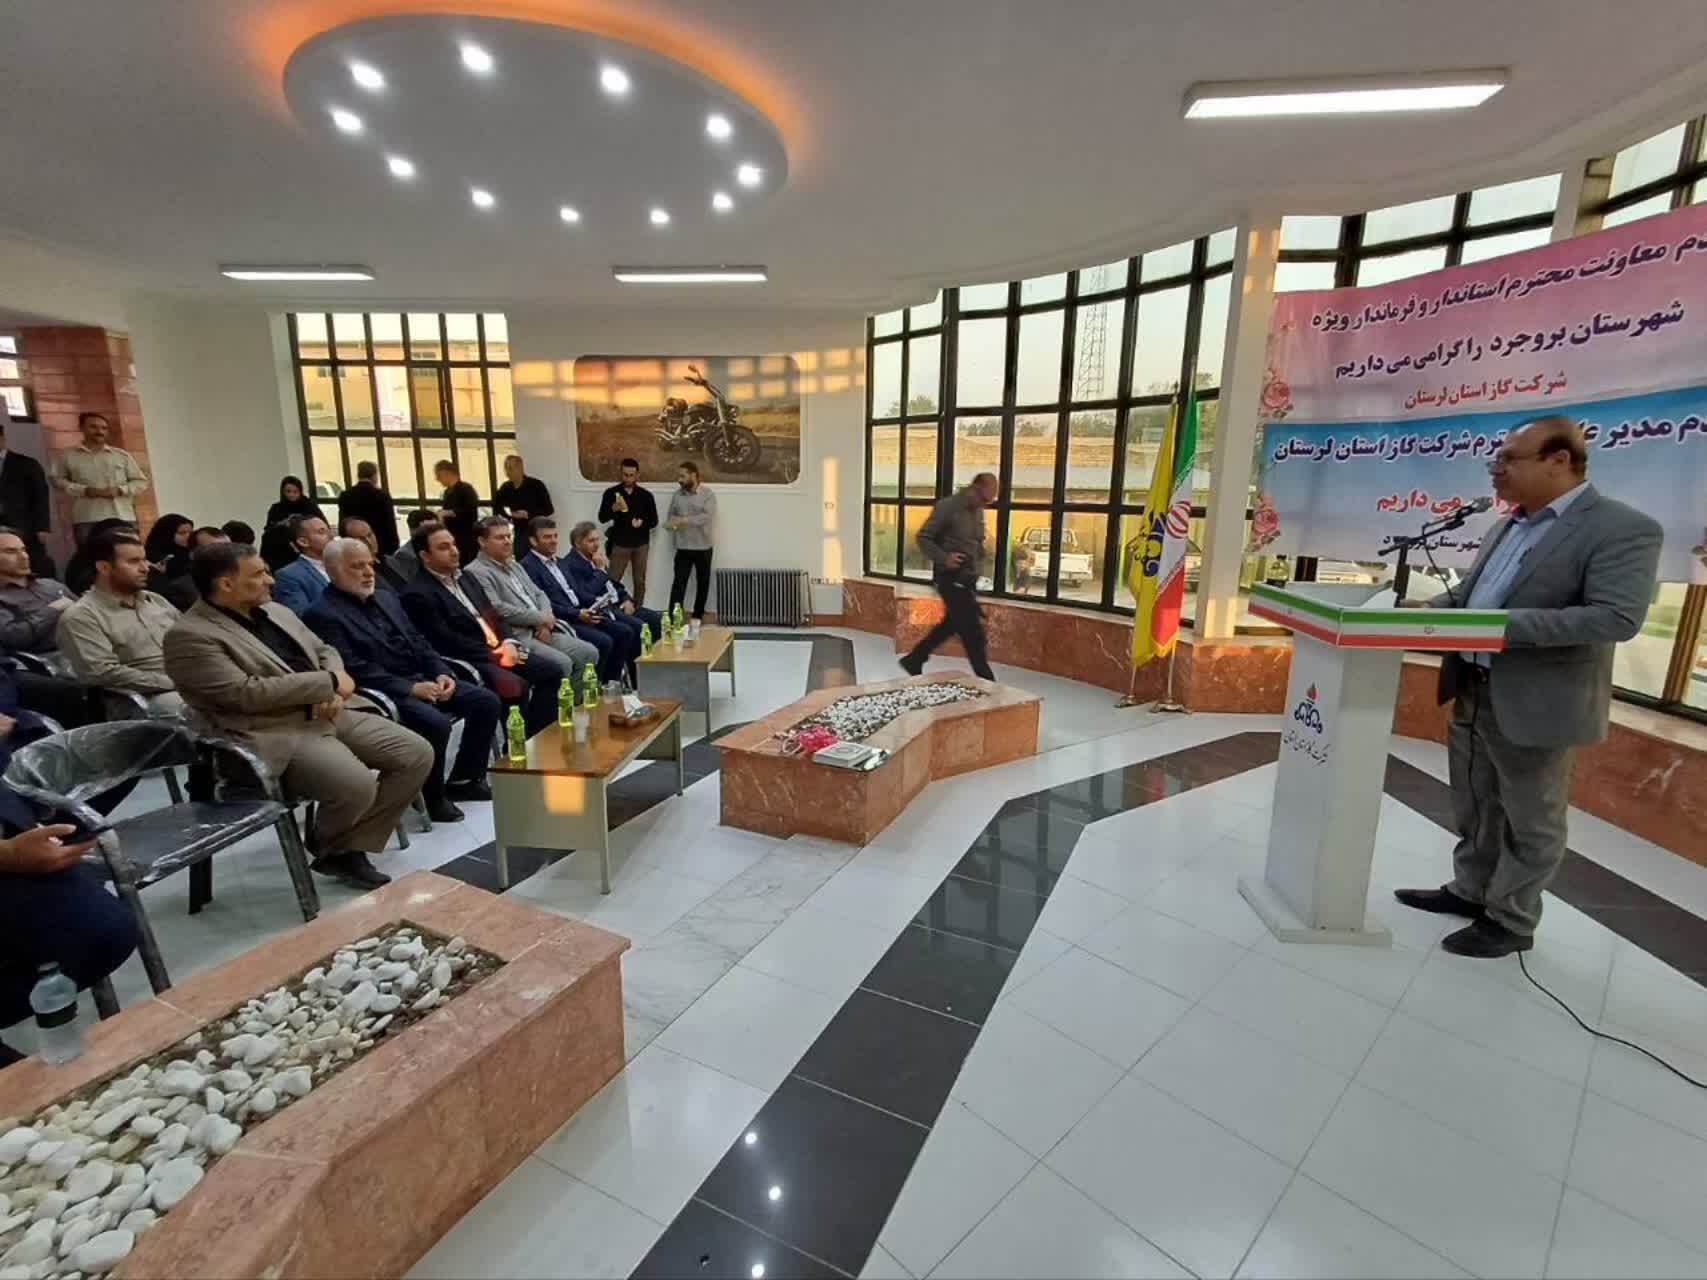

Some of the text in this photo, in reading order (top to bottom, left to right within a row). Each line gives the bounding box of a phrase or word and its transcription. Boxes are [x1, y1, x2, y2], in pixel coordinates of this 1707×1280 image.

[1579, 245, 1666, 276] معاونت
[1431, 278, 1507, 315] استاندار
[1504, 268, 1574, 298] محترم
[1312, 311, 1349, 331] ویژه
[1353, 296, 1415, 329] فرماندار
[1419, 302, 1427, 317] و
[1336, 301, 1684, 378] شهرستان بروجرد را گرامی می داریم
[1404, 372, 1567, 408] شرکت گاز استان لرستان
[1419, 432, 1471, 458] شرکت
[1601, 420, 1672, 448] مدیر
[1274, 438, 1333, 460] لرستان
[1336, 437, 1385, 460] استان
[1385, 437, 1417, 460] گاز
[1377, 489, 1427, 512] داریم
